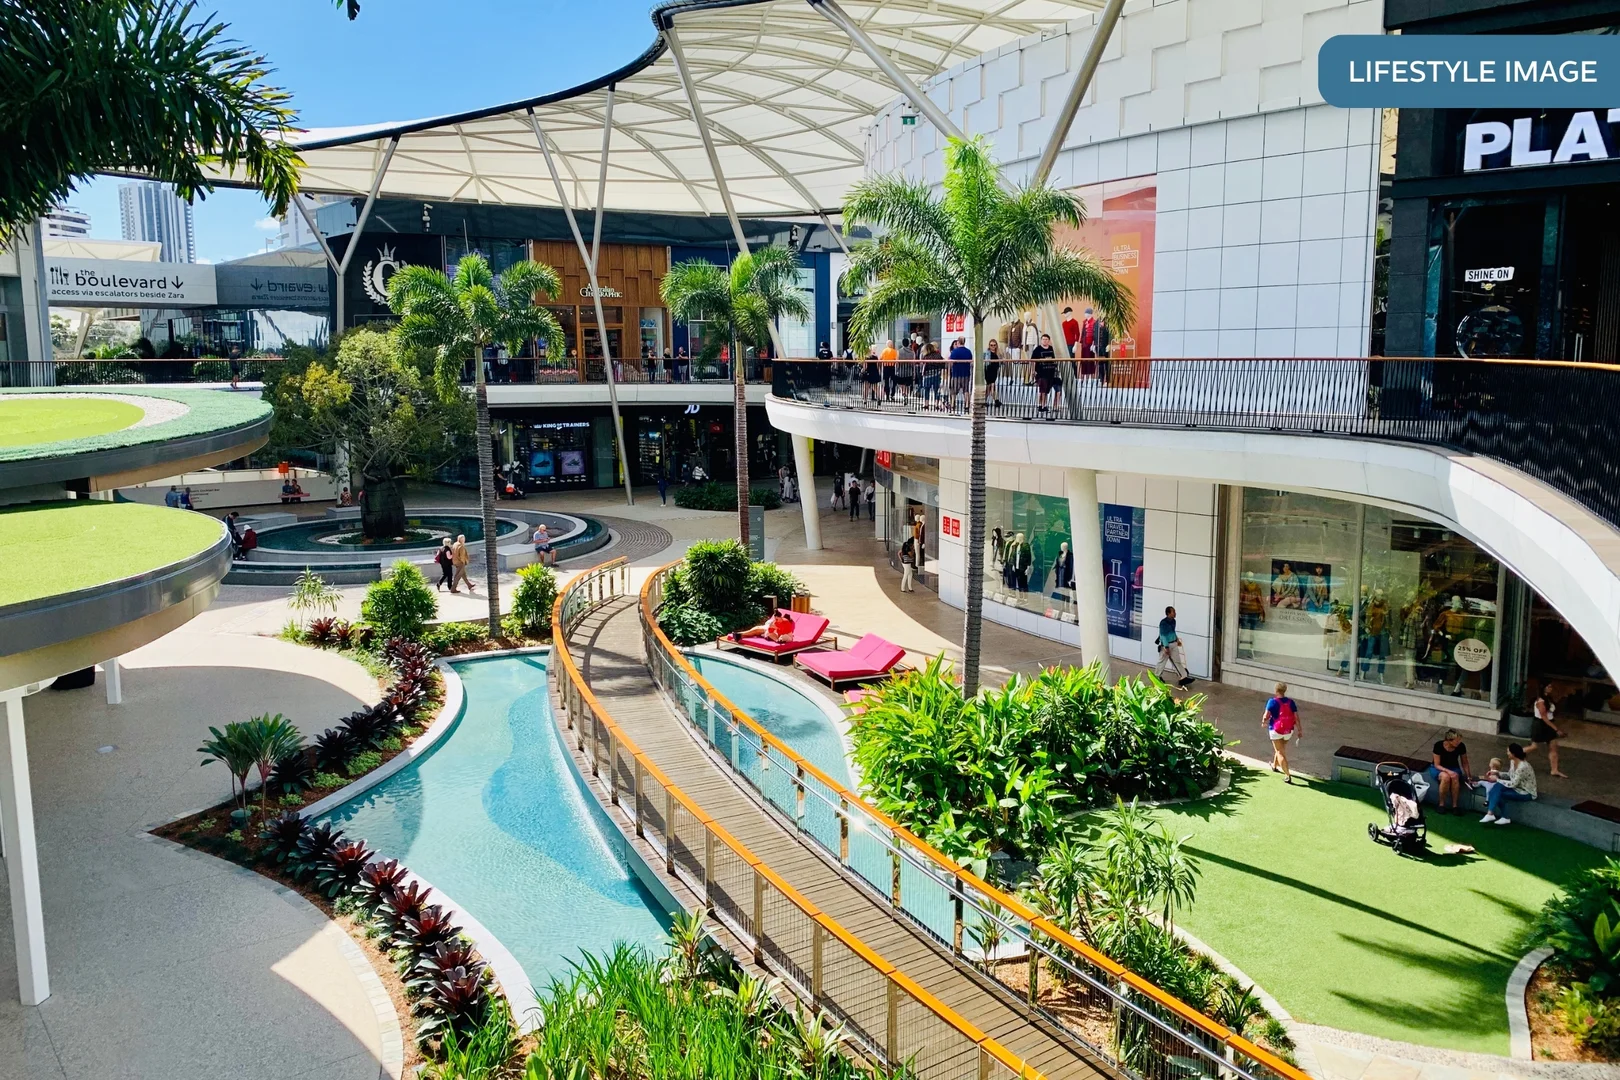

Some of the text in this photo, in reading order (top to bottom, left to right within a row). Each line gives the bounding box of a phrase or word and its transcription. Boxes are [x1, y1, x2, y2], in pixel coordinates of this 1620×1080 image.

[80, 269, 96, 277] the
[1468, 269, 1509, 280] SHINE ON
[75, 272, 167, 289] boulevard
[95, 290, 138, 298] escalators
[140, 291, 166, 299] beside
[684, 404, 700, 414] JD
[1106, 515, 1123, 523] ULTRA
[1107, 523, 1124, 531] TRAVEL
[1106, 528, 1128, 537] PARTNER
